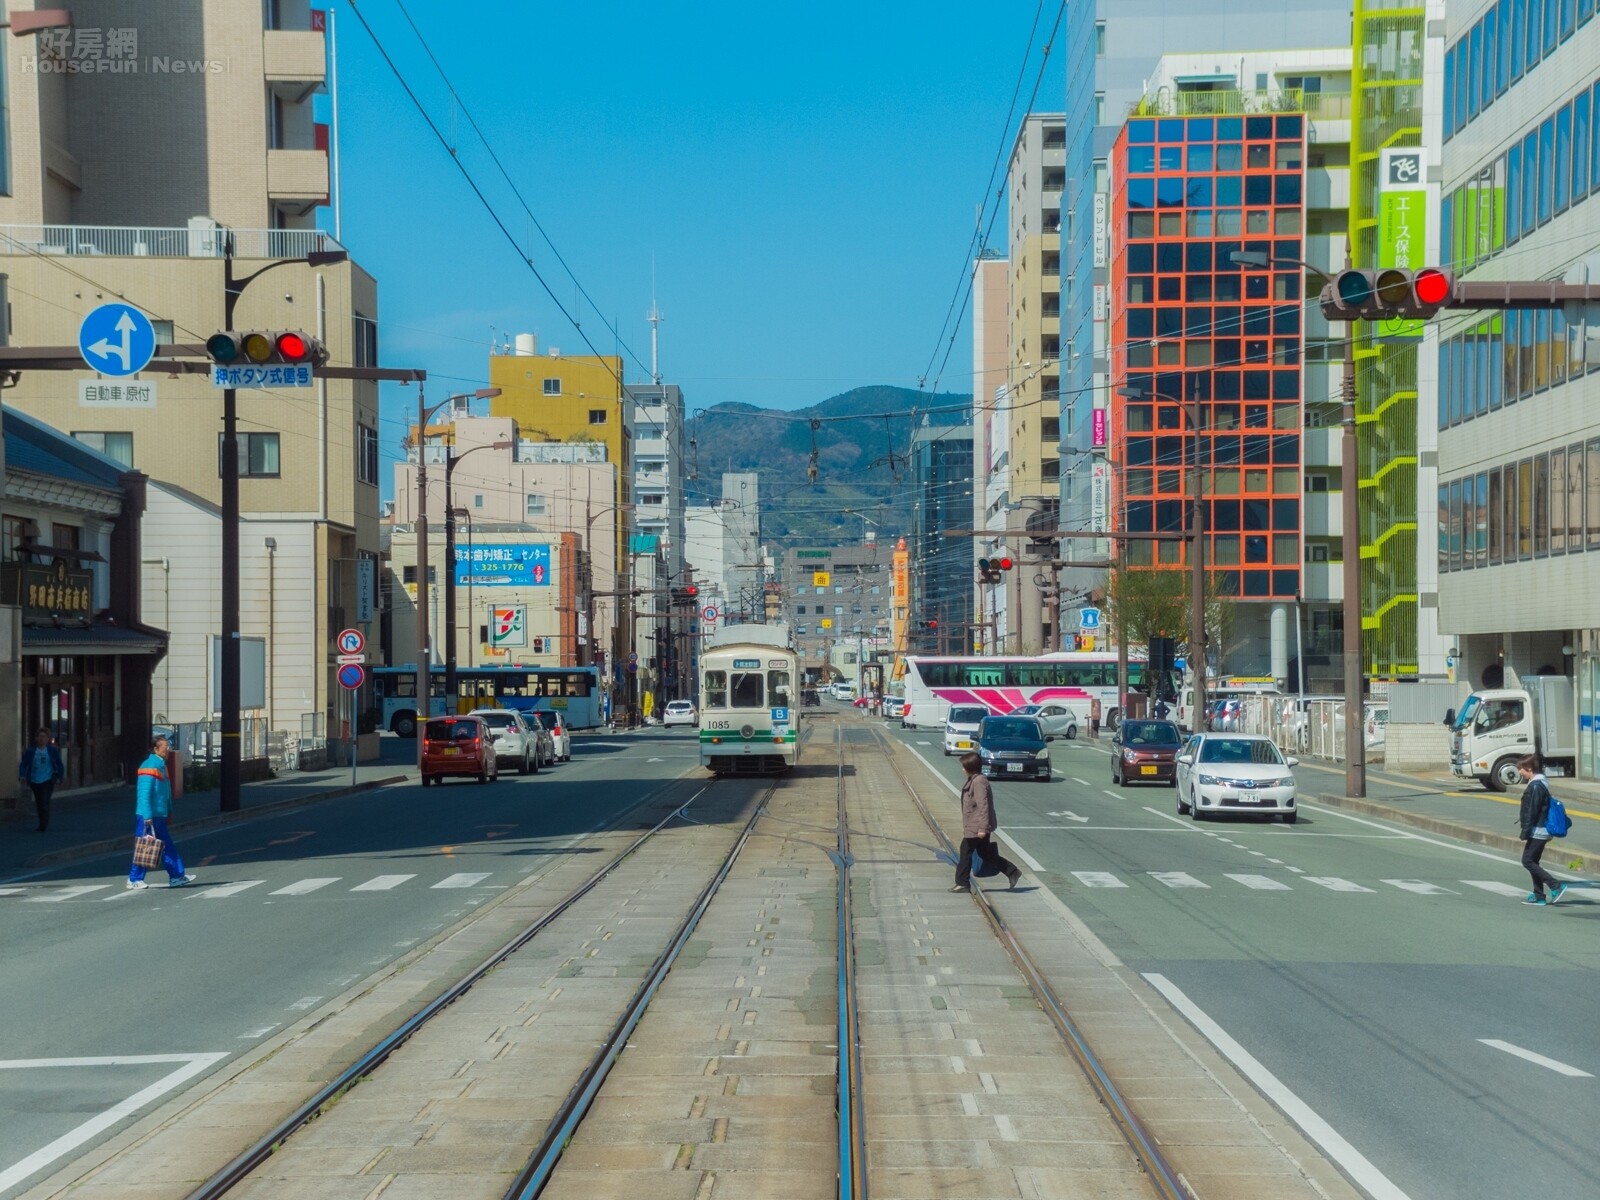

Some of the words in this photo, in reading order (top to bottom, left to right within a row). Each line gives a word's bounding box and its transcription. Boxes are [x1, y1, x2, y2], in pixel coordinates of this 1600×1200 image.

[1395, 197, 1411, 268] エース保険
[215, 367, 310, 386] 押ボタン式信号
[481, 563, 524, 571] 325-1776
[776, 709, 784, 719] B
[708, 720, 730, 729] 1085
